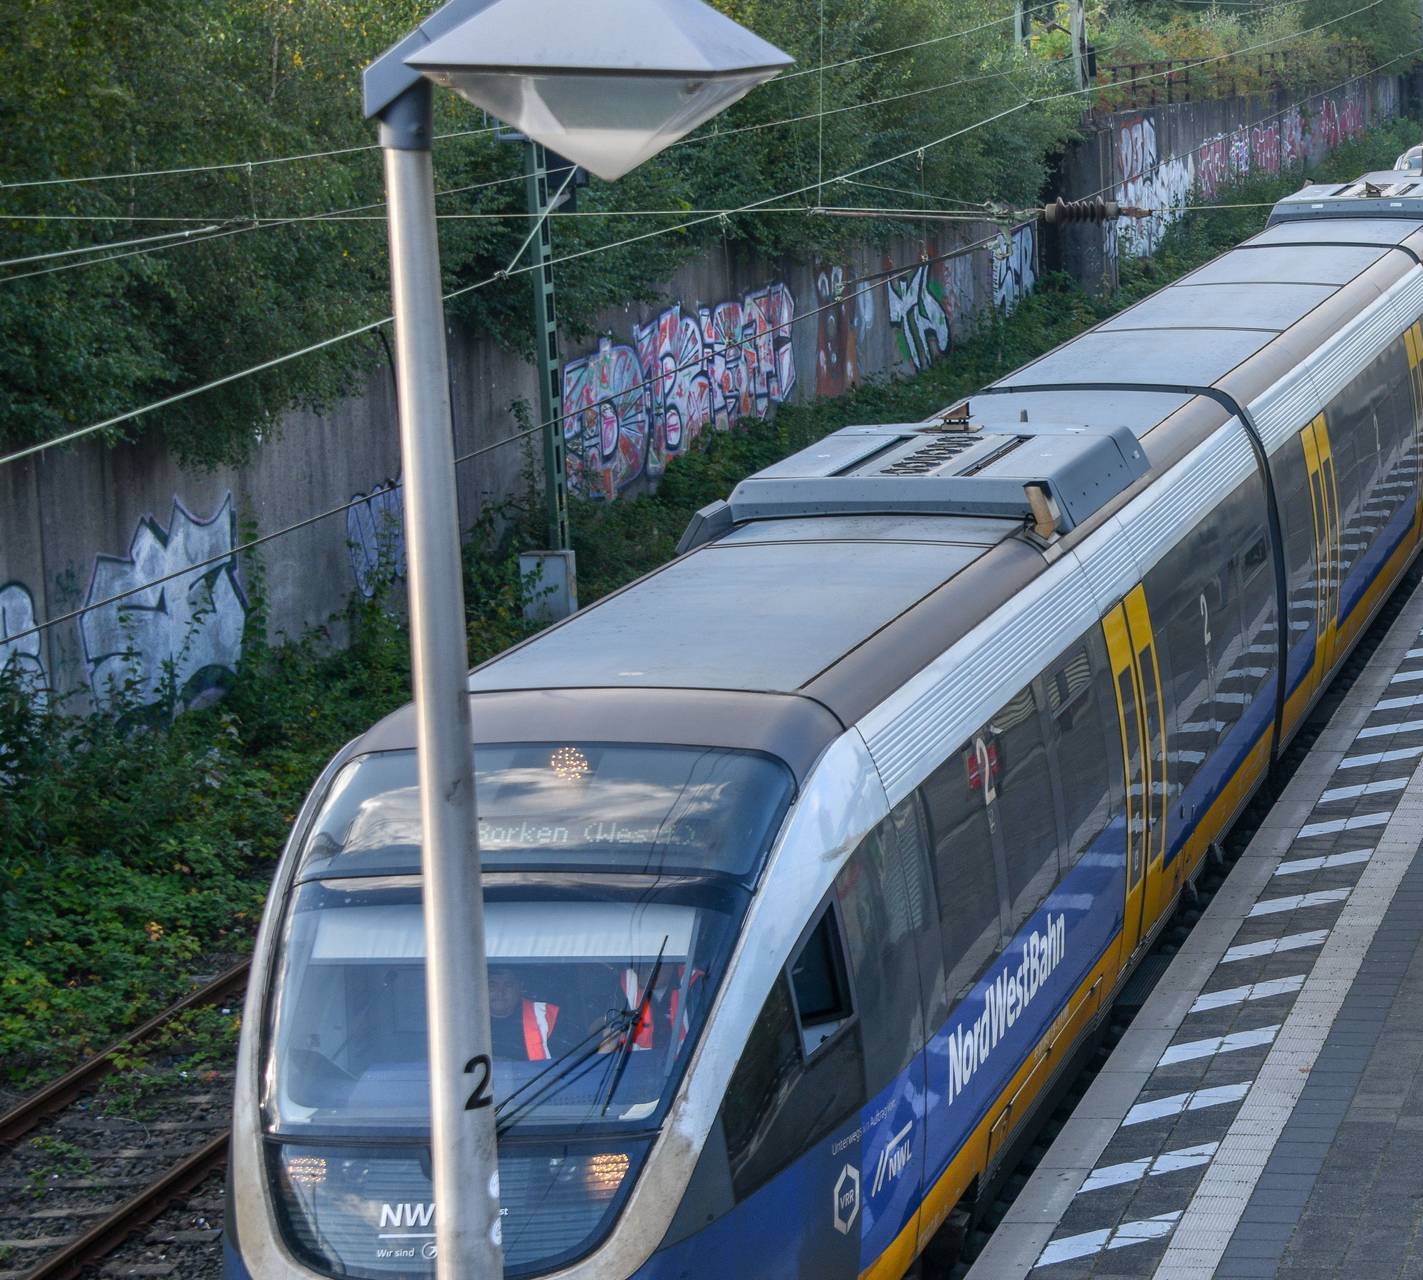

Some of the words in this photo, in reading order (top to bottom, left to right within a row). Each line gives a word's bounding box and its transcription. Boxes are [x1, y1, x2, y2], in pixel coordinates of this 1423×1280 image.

[1200, 593, 1211, 646] 2
[975, 737, 997, 806] 2
[478, 821, 569, 843] Borken
[948, 912, 1065, 1106] NordWestBahn
[464, 1054, 493, 1111] 2
[888, 1139, 913, 1181] NWL
[379, 1203, 437, 1227] NW
[839, 1188, 855, 1209] VRR
[377, 1249, 392, 1257] Wir
[395, 1248, 414, 1257] sind
